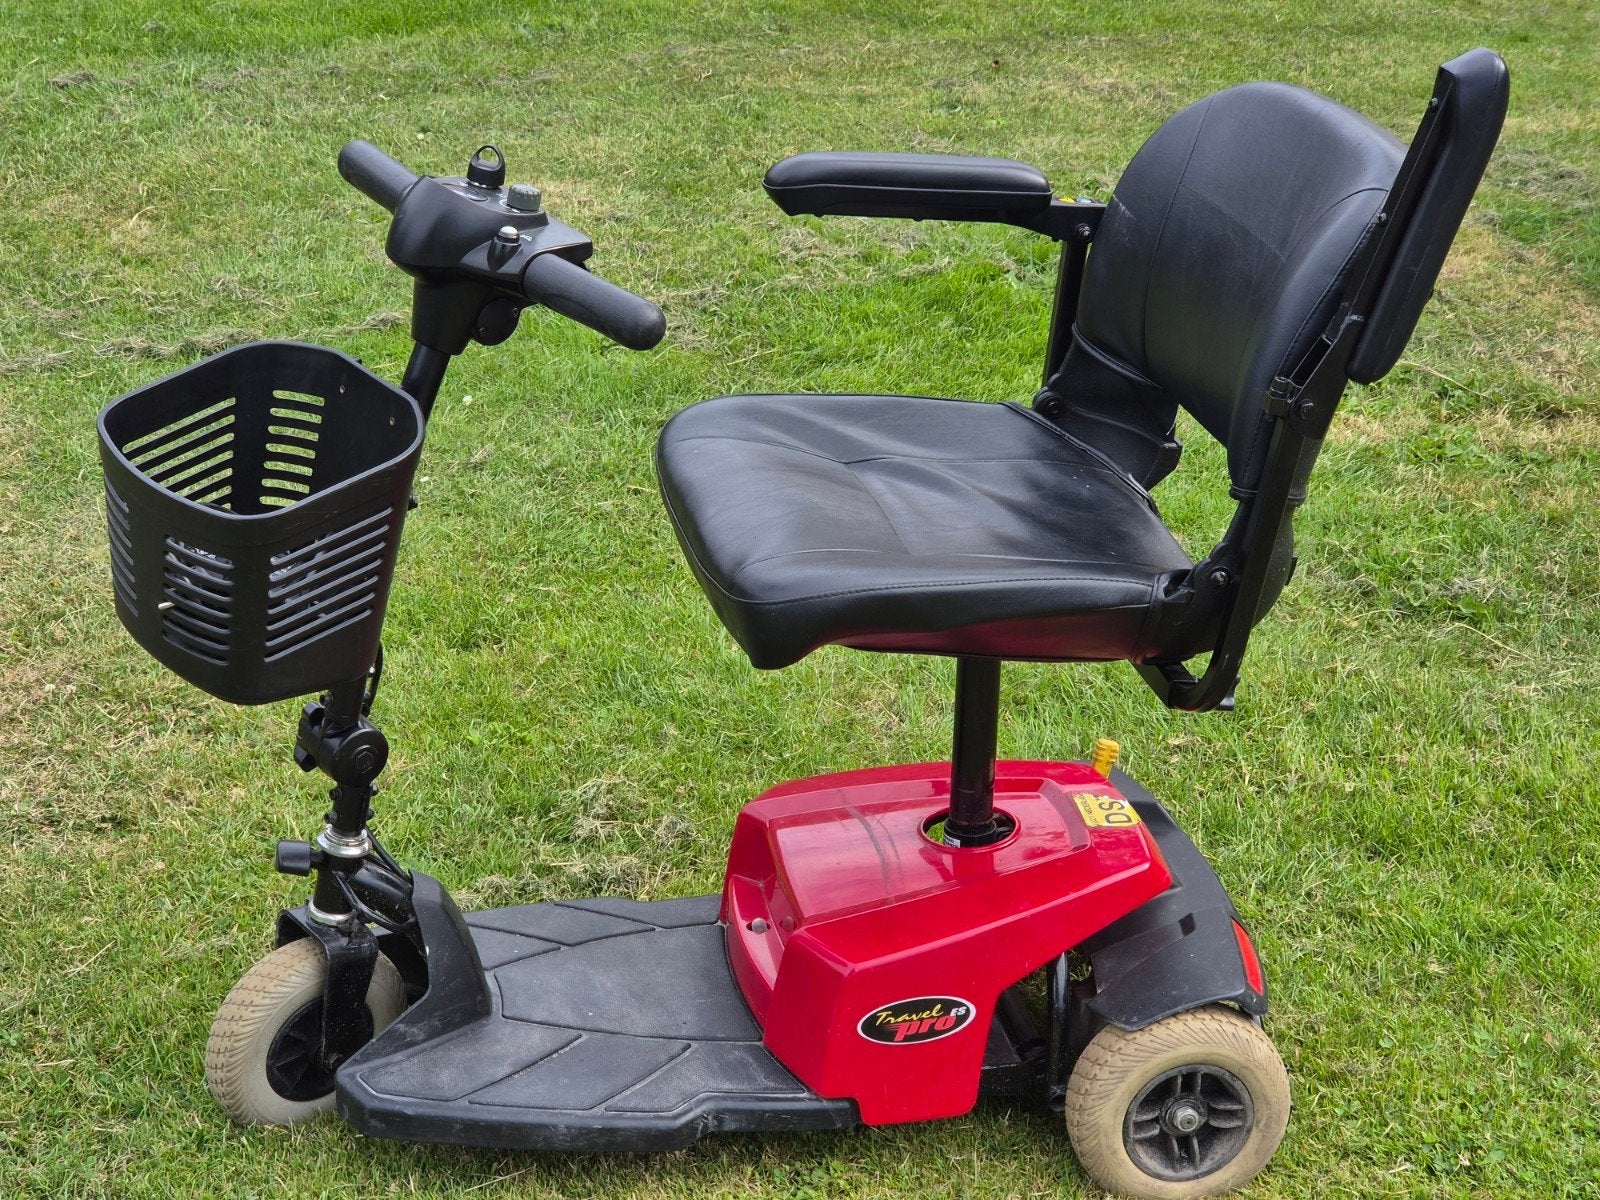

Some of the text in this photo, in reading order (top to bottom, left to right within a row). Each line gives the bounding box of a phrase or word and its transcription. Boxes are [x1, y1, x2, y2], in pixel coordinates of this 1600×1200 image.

[1096, 797, 1132, 824] DS
[876, 1004, 944, 1026] Travel
[893, 1006, 967, 1042] pro ES
